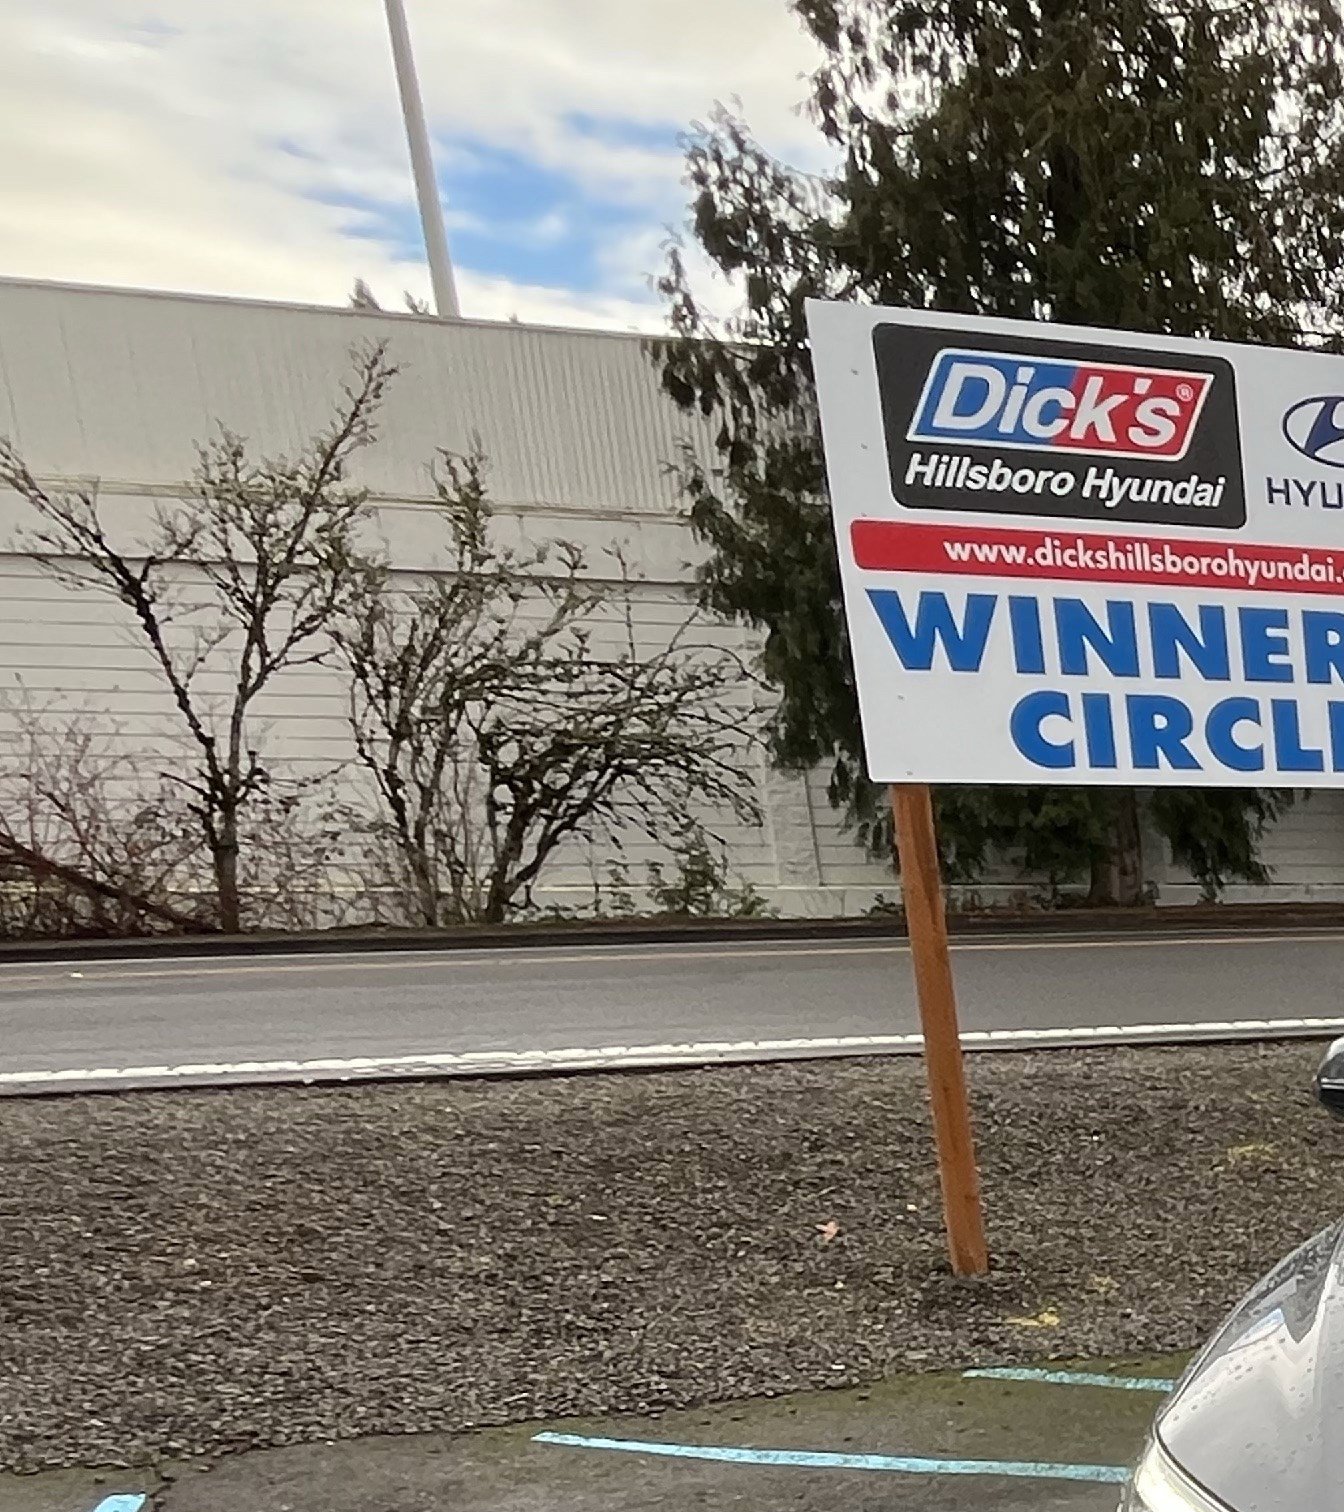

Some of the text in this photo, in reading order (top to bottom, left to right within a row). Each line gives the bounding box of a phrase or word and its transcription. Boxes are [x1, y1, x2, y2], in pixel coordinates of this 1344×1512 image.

[932, 362, 1182, 448] Dick's
[904, 452, 1226, 508] Hillsboro Hyundai
